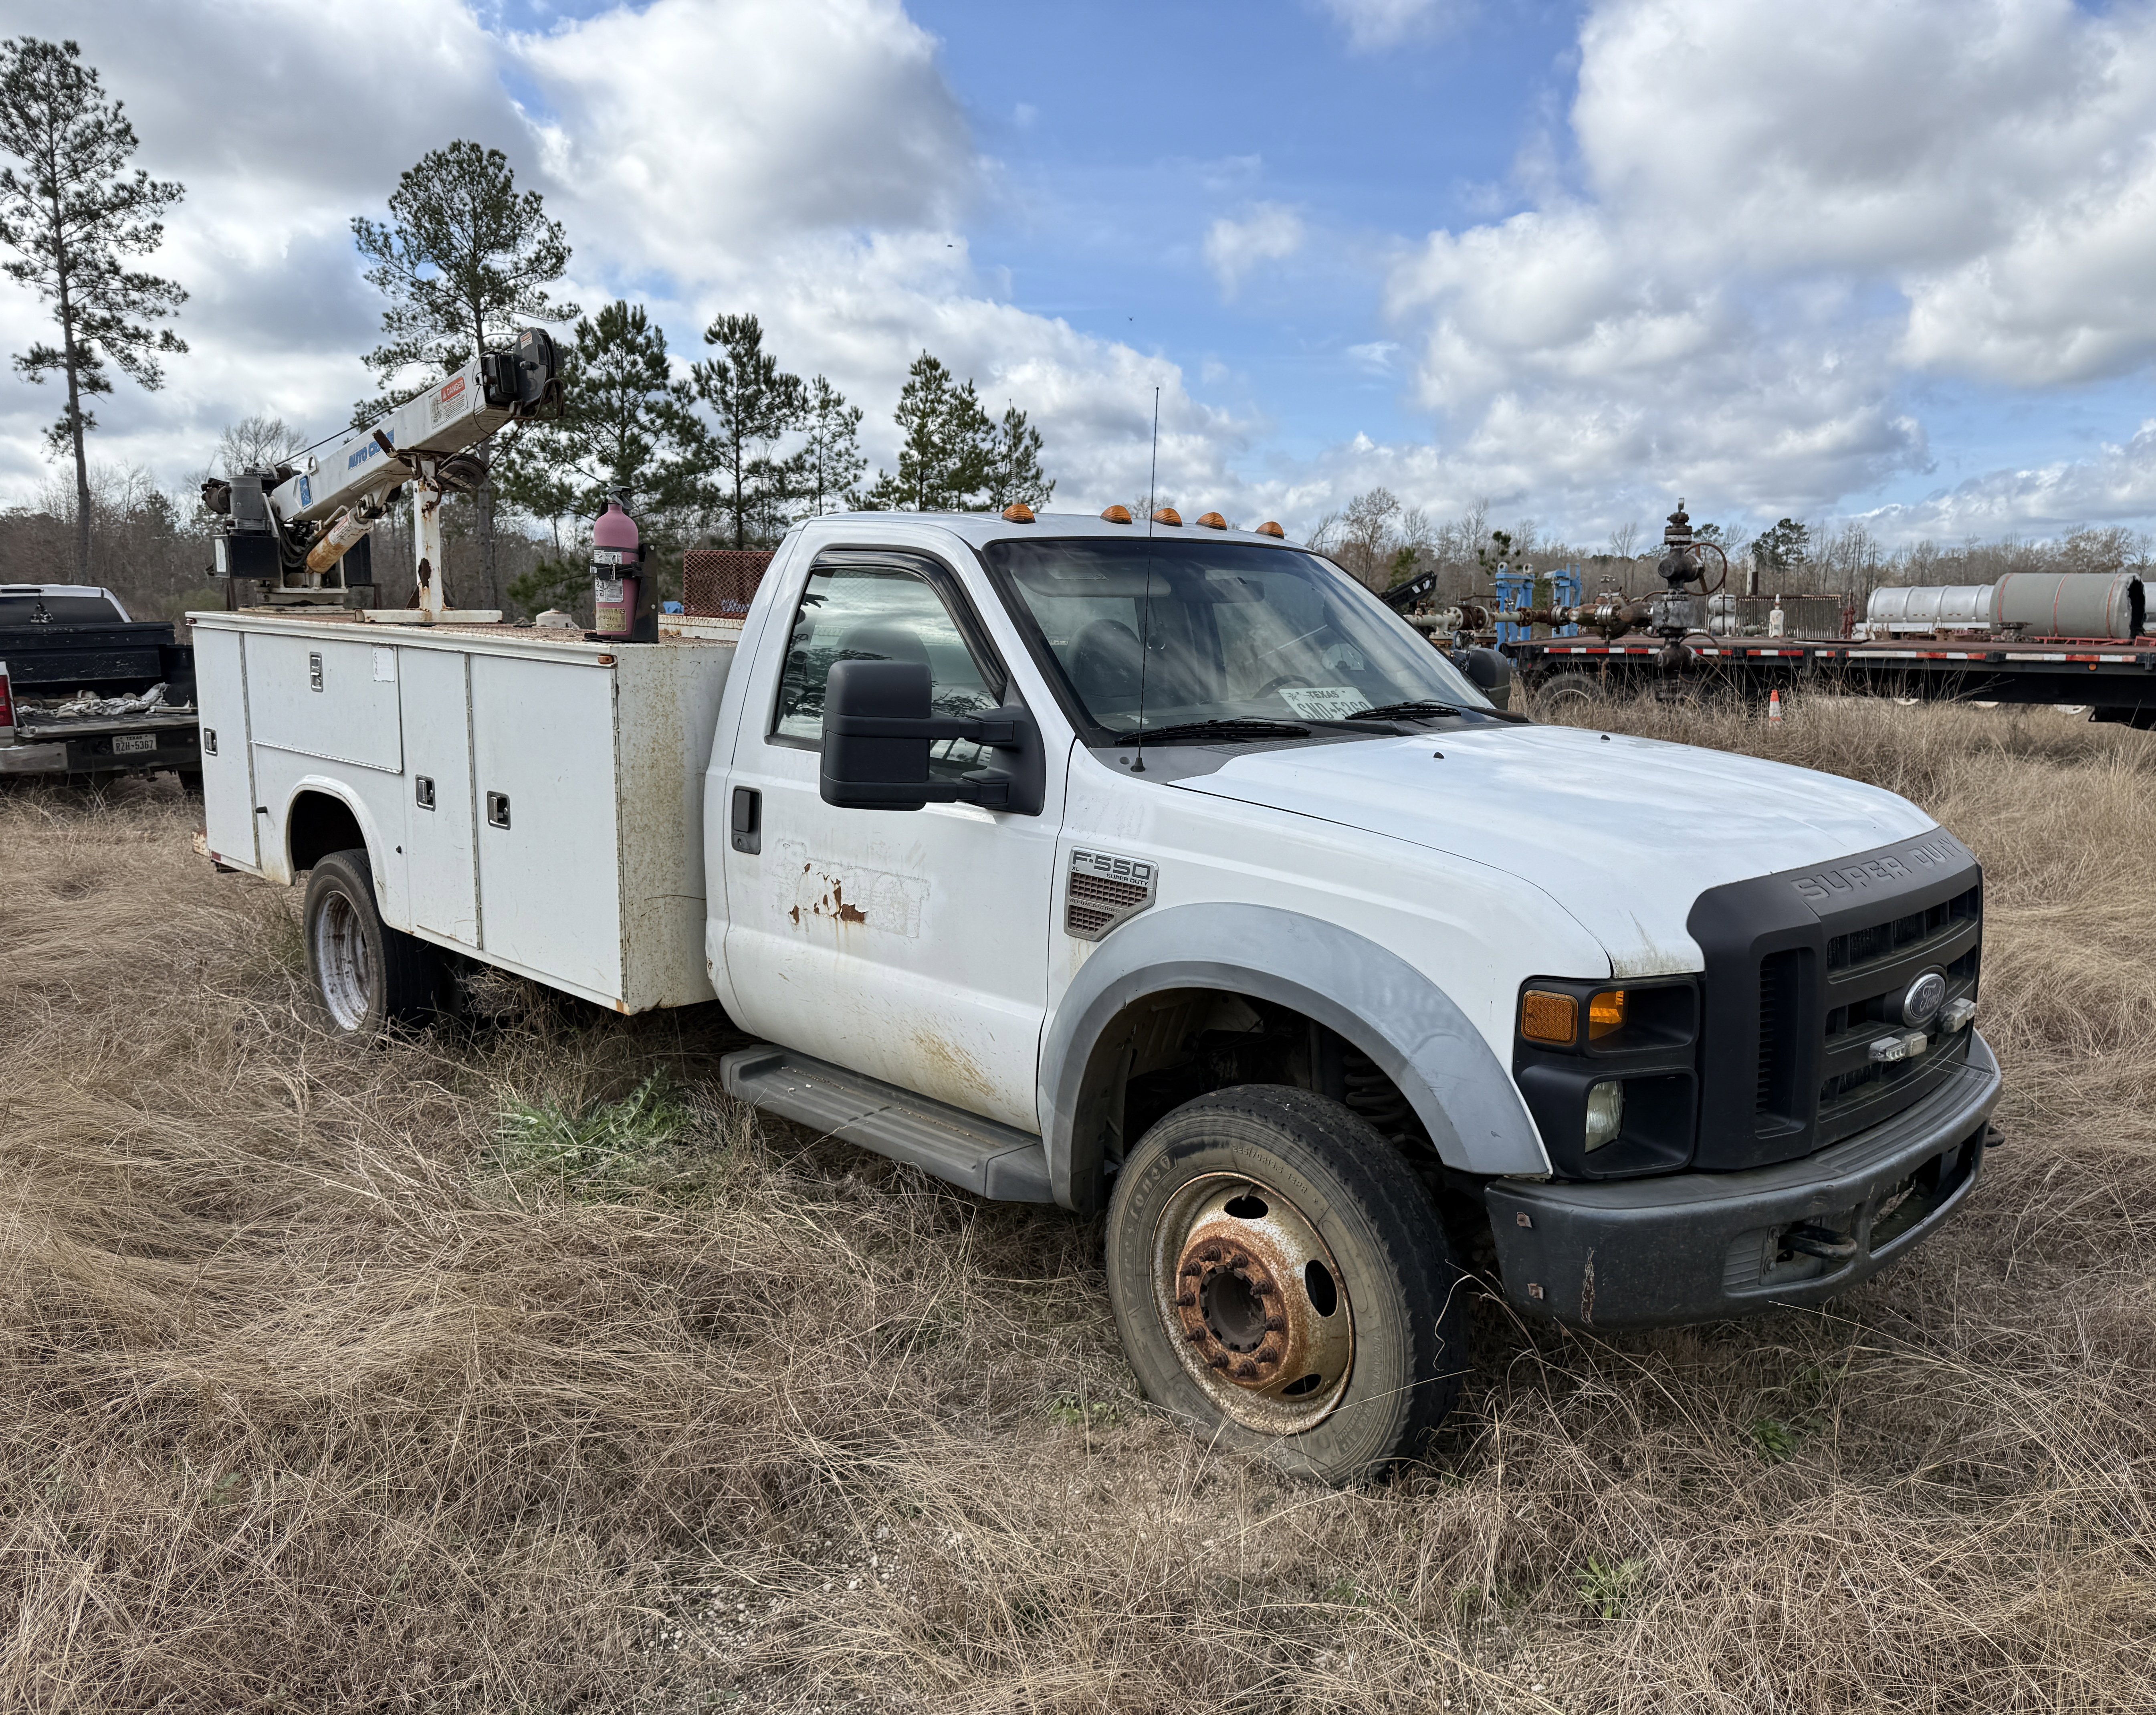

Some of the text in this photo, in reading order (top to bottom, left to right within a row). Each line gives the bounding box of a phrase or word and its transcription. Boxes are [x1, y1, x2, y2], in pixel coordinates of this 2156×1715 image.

[447, 380, 464, 396] DANGER
[348, 446, 367, 470] AUTO
[1306, 691, 1340, 699] TEXAS
[1106, 873, 1128, 882] SUPER
[1791, 836, 1962, 901] SUPER DUTY
[1919, 983, 1942, 1012] Ford
